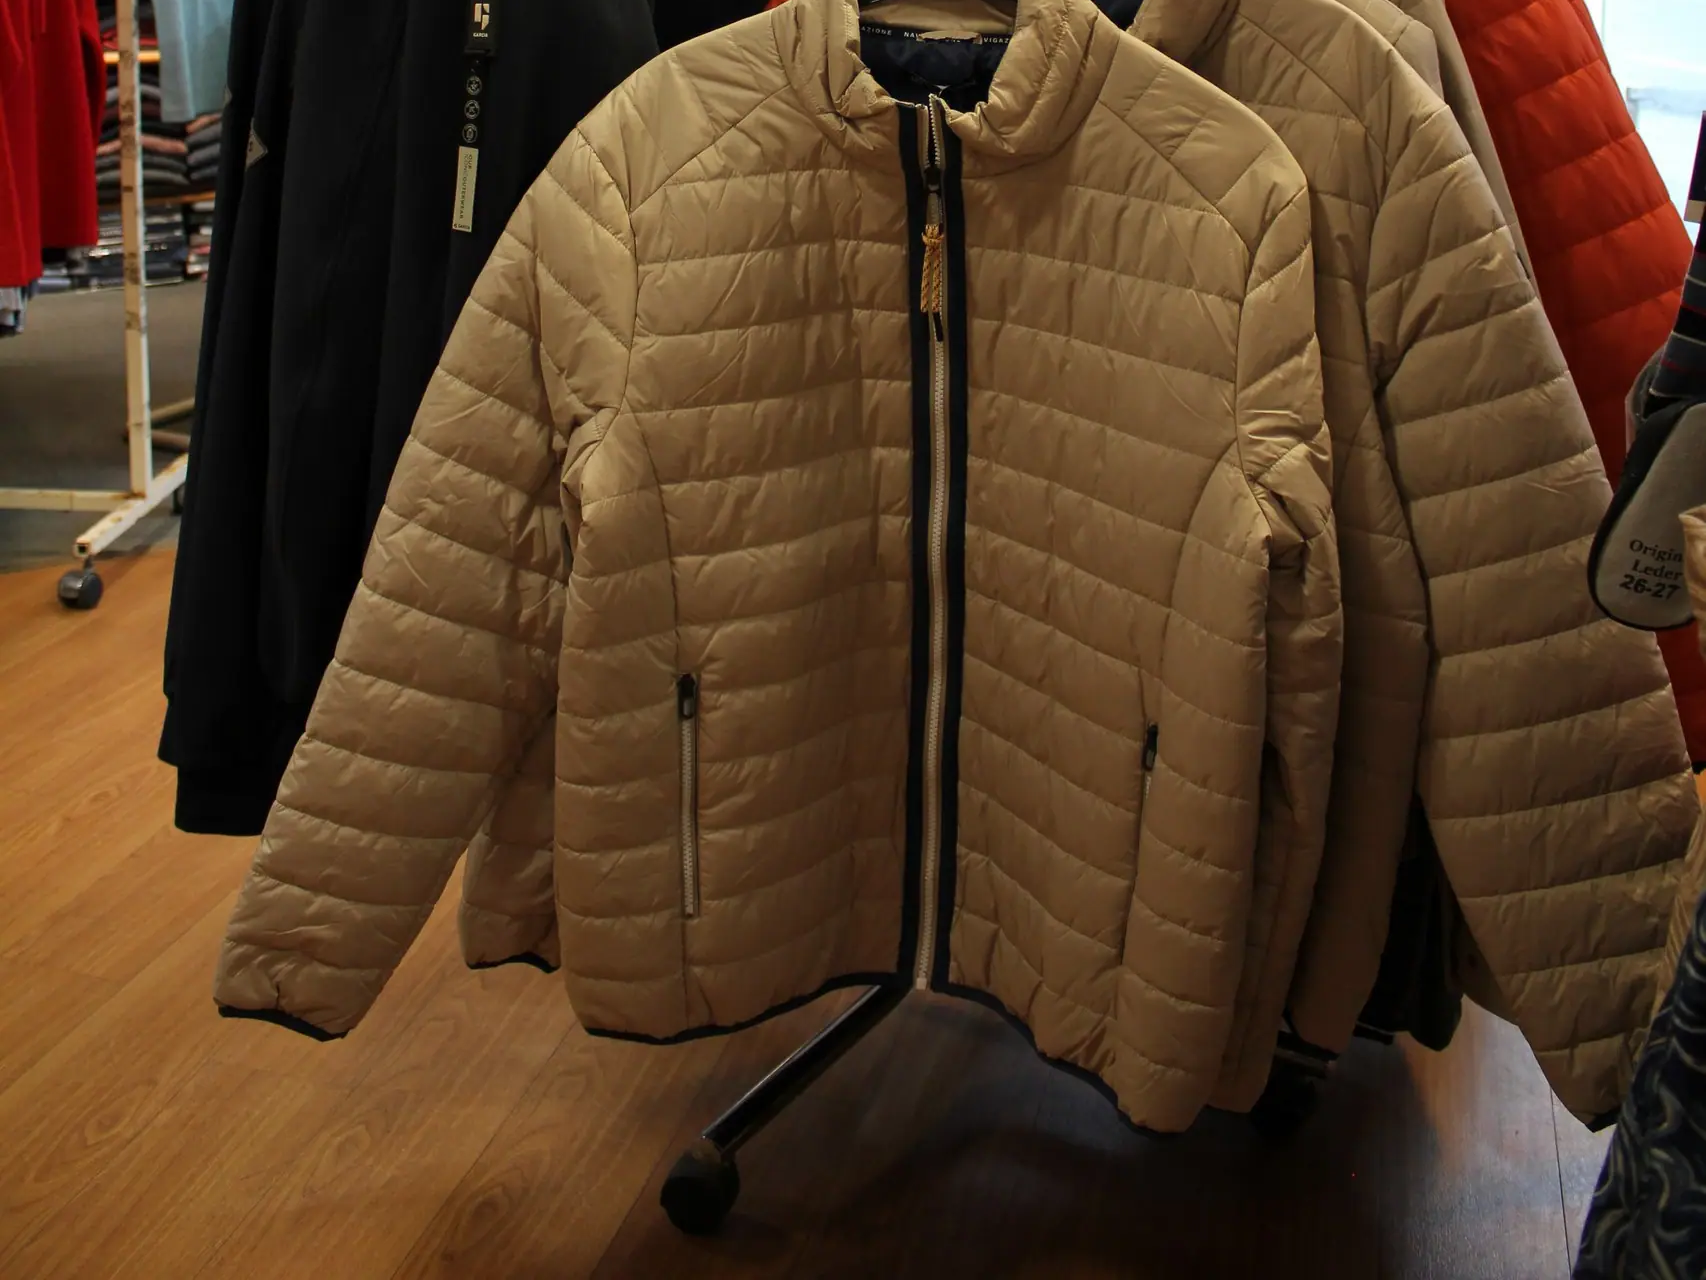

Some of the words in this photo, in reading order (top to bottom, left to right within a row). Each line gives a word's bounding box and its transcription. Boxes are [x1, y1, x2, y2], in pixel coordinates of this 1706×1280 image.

[861, 26, 893, 36] AZIONE
[459, 176, 467, 220] OUTERWEAR
[1629, 539, 1683, 562] Origin
[1632, 559, 1684, 581] Leder
[1619, 574, 1682, 600] 26-27
